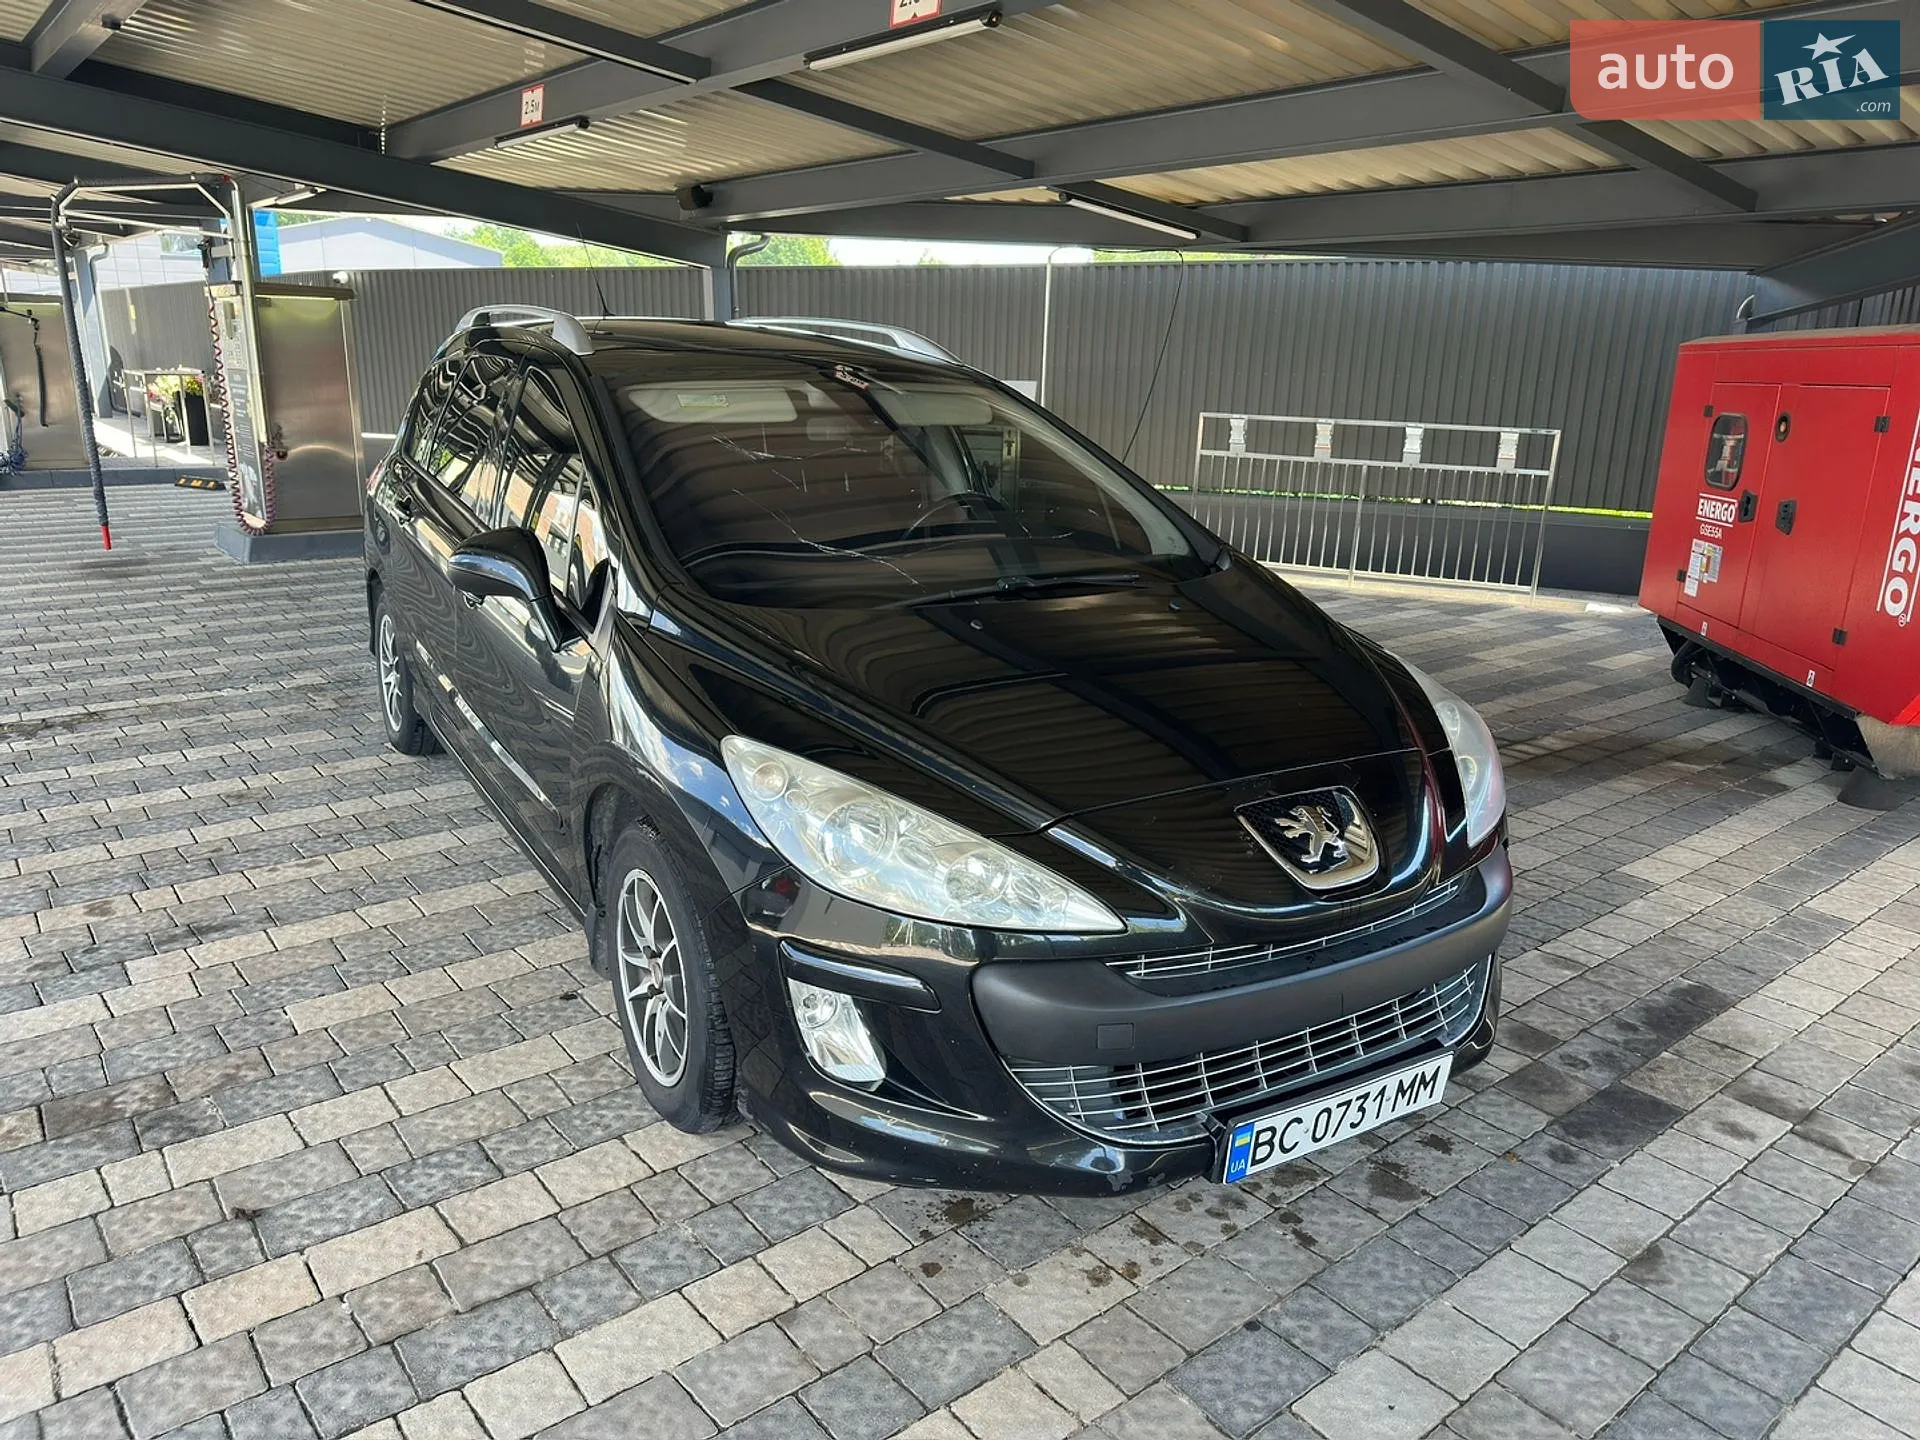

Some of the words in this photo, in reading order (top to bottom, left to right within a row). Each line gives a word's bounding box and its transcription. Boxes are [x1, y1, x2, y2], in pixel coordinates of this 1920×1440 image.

[1697, 498, 1736, 523] ENERGO
[1250, 1117, 1304, 1168] BC
[1310, 1085, 1388, 1144] 0731
[1391, 1065, 1441, 1113] MM
[1230, 1160, 1246, 1174] UA
